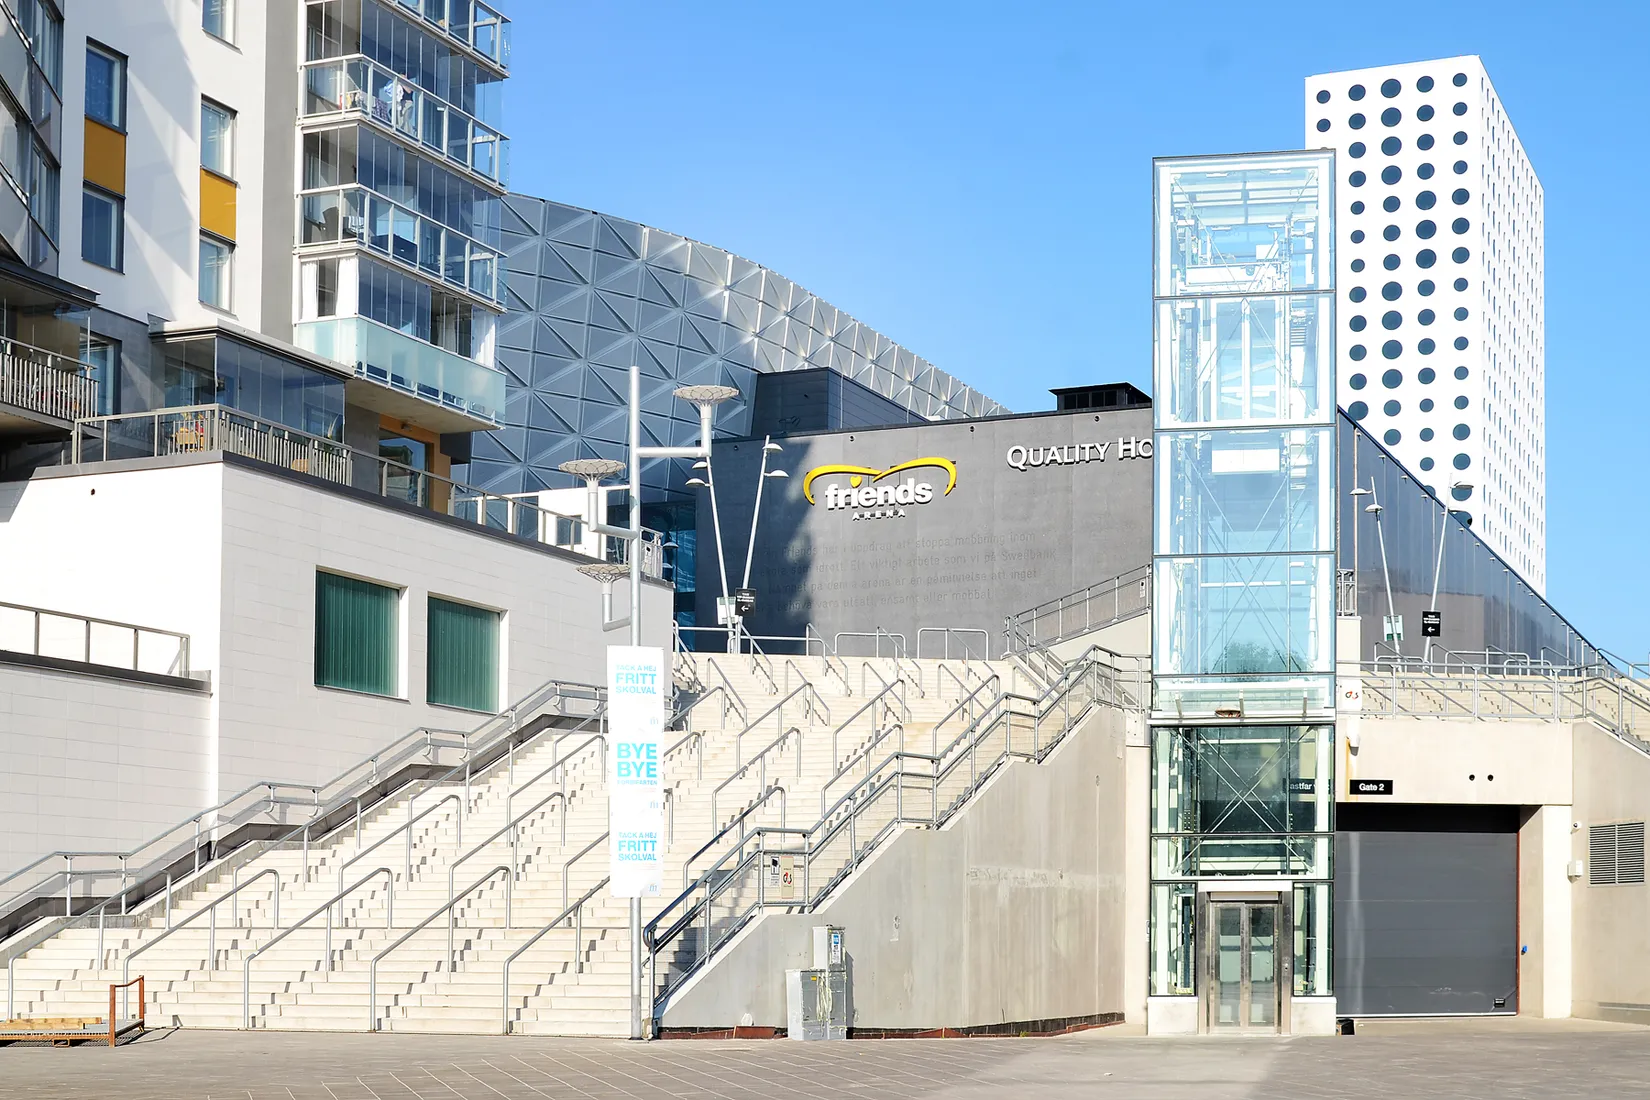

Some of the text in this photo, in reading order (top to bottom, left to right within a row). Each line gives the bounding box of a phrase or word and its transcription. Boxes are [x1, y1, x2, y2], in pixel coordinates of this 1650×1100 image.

[1007, 442, 1111, 470] QUALITY
[825, 477, 933, 510] friends
[852, 508, 907, 521] ARENA
[915, 537, 950, 550] stoppa
[955, 531, 1005, 546] mobbning
[1009, 530, 1036, 543] inom
[906, 555, 941, 567] arbete
[944, 555, 966, 565] som
[1001, 547, 1057, 562] Swedbank
[861, 578, 891, 590] arena
[1011, 567, 1037, 582] inget
[923, 591, 948, 602] eller
[615, 672, 657, 685] FRITT
[615, 685, 657, 695] SKOLVAL
[617, 742, 657, 759] BYE
[617, 761, 657, 778] BYE
[1358, 783, 1385, 791] Gate 2
[644, 831, 657, 839] HEJ
[618, 840, 657, 852] FRITT
[618, 853, 657, 862] SKOLVAL
